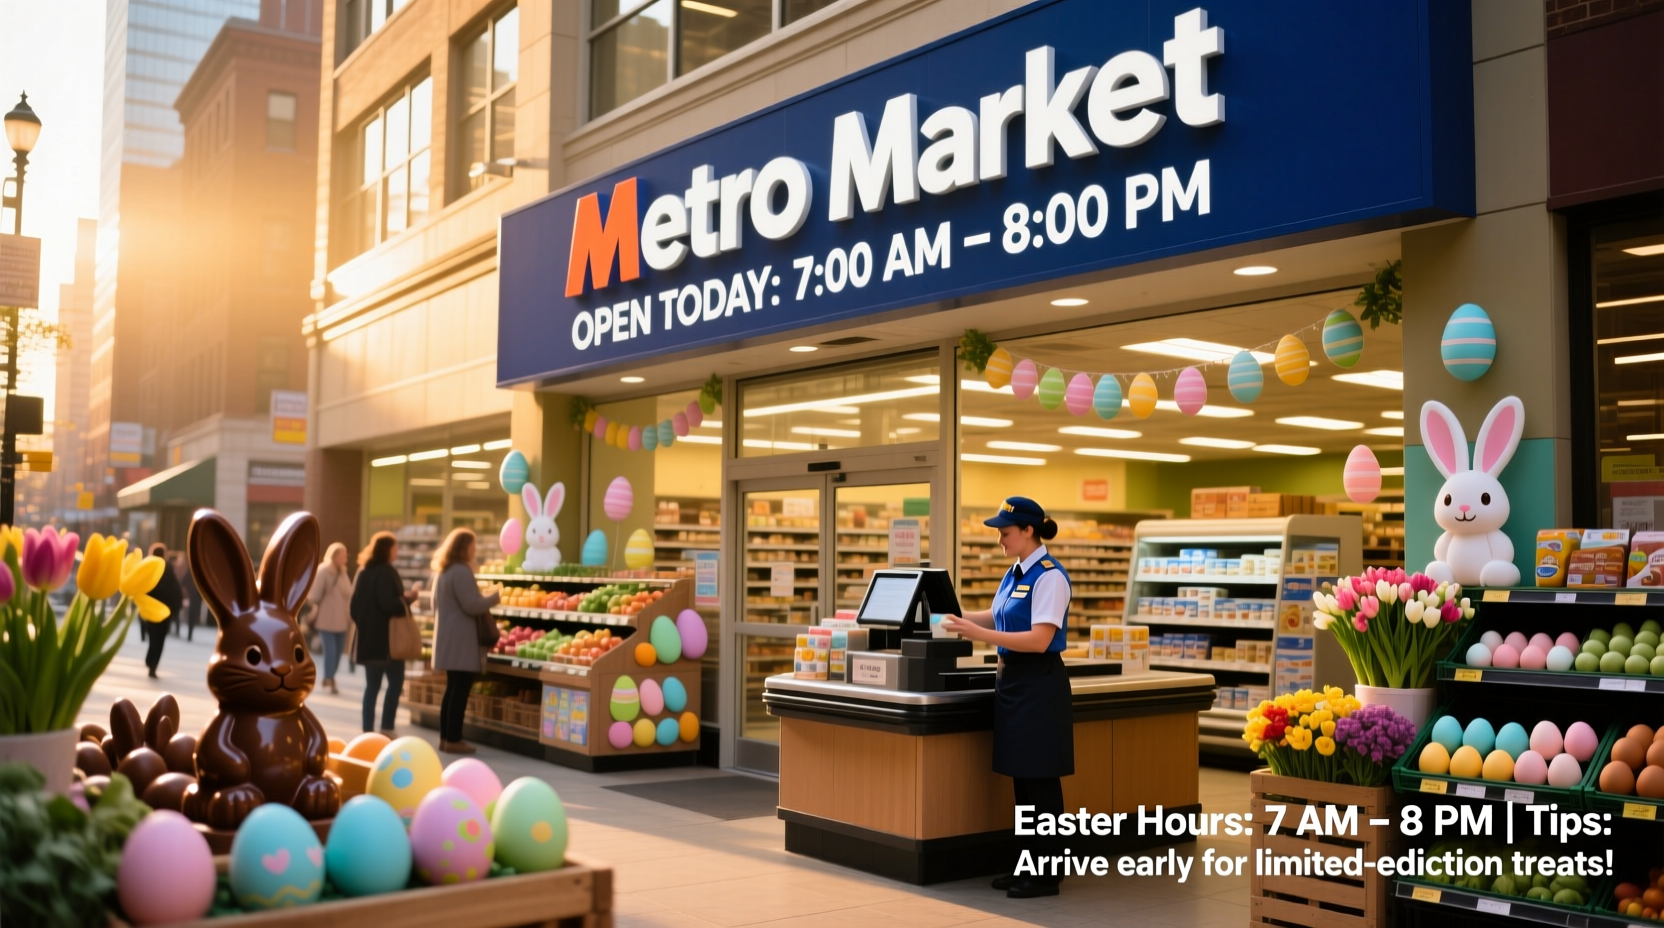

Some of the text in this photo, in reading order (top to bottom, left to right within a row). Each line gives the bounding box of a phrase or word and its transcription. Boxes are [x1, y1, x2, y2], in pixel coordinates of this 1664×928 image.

[565, 7, 1226, 299] Metro Market
[571, 295, 652, 350] OPEN
[659, 265, 781, 330] TODAY:
[793, 241, 873, 300] 7:00
[882, 221, 951, 282] AM
[1002, 184, 1109, 254] 8:00
[1125, 159, 1211, 230] PM
